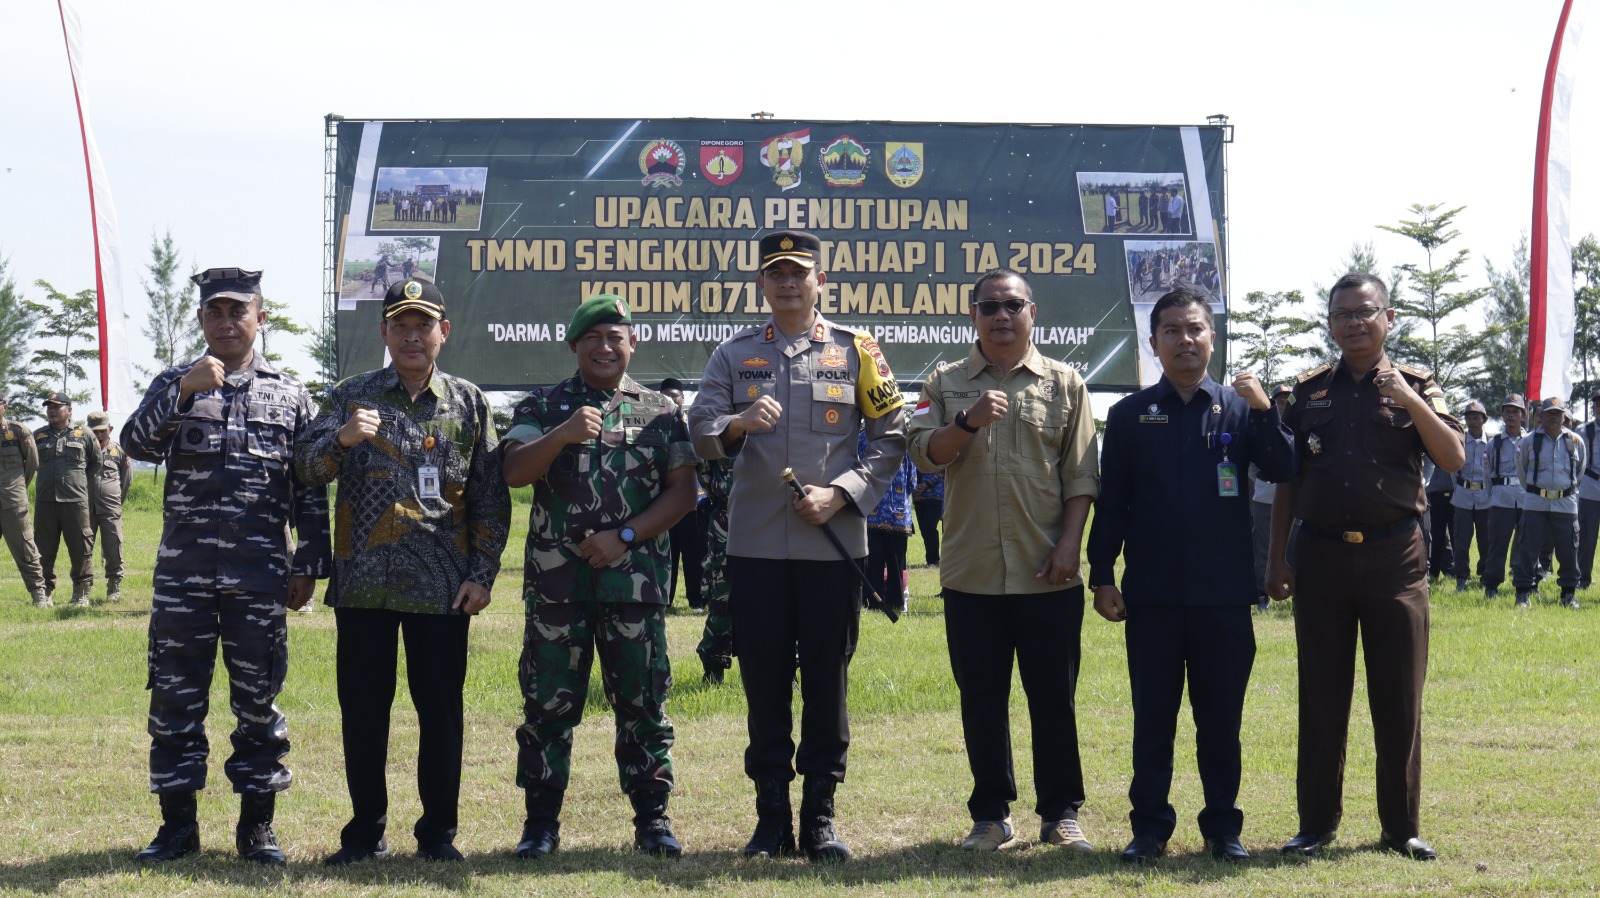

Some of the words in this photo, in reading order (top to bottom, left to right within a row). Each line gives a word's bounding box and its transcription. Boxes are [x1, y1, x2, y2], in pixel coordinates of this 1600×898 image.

[595, 196, 757, 229] UPACARA
[764, 197, 968, 231] PENUTUPAN
[466, 239, 566, 271] TMMD
[575, 239, 760, 272] SENGKUYU
[819, 240, 926, 273] TAHAP
[935, 241, 945, 273] I
[960, 241, 1000, 273] TA
[1008, 242, 1097, 274] 2024
[819, 282, 975, 315] EMALAN
[487, 323, 552, 342] "DARMA
[657, 323, 760, 343] MEWUJUDK
[874, 325, 980, 344] PEMBANGUNA
[738, 370, 773, 380] YOVAN
[816, 370, 851, 381] POLRI
[257, 390, 274, 401] TNI
[624, 417, 646, 425] TNI
